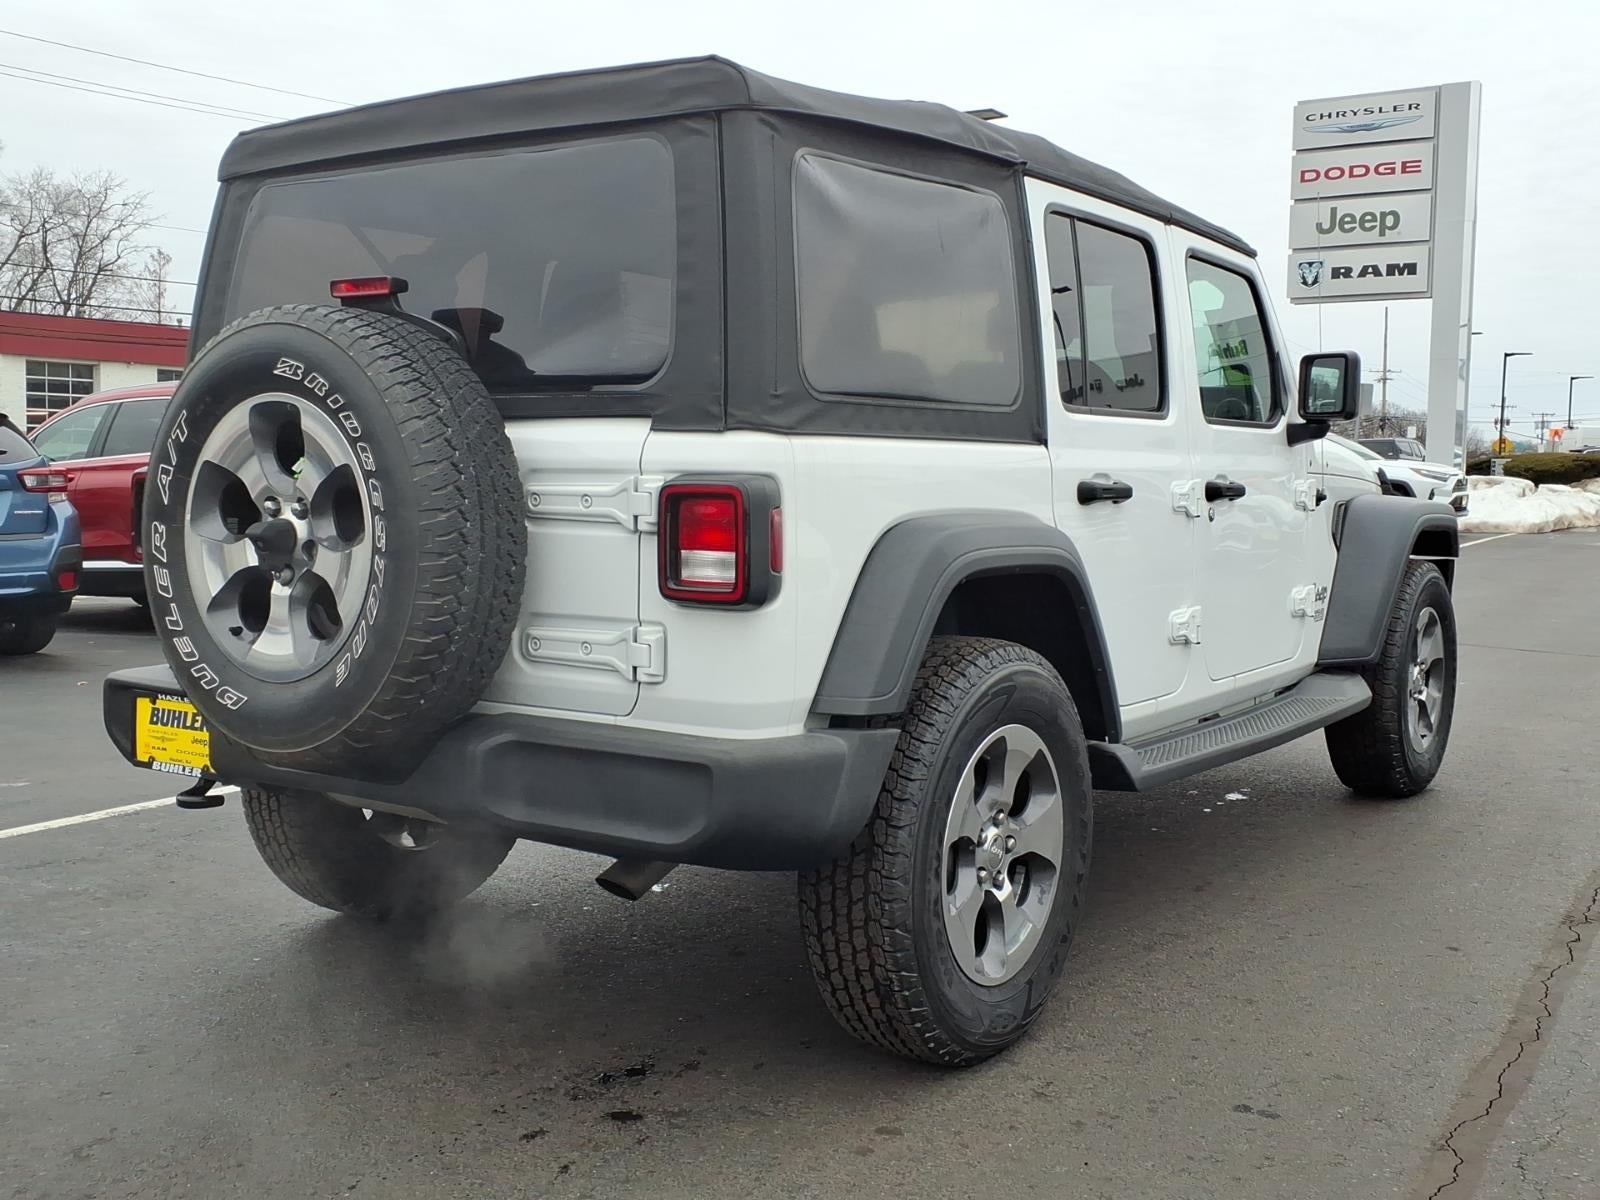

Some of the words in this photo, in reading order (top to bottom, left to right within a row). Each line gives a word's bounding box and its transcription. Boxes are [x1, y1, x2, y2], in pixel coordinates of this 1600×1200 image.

[1305, 102, 1422, 122] CHRYSLER
[1299, 159, 1423, 184] DODGE
[1315, 206, 1401, 237] Jeep
[1330, 262, 1418, 280] RAM
[157, 408, 188, 507] A/T
[273, 357, 387, 688] BRIDGESTONE
[152, 521, 248, 711] DUELER
[158, 694, 191, 703] HAZLE
[152, 761, 202, 777] BUHLER
